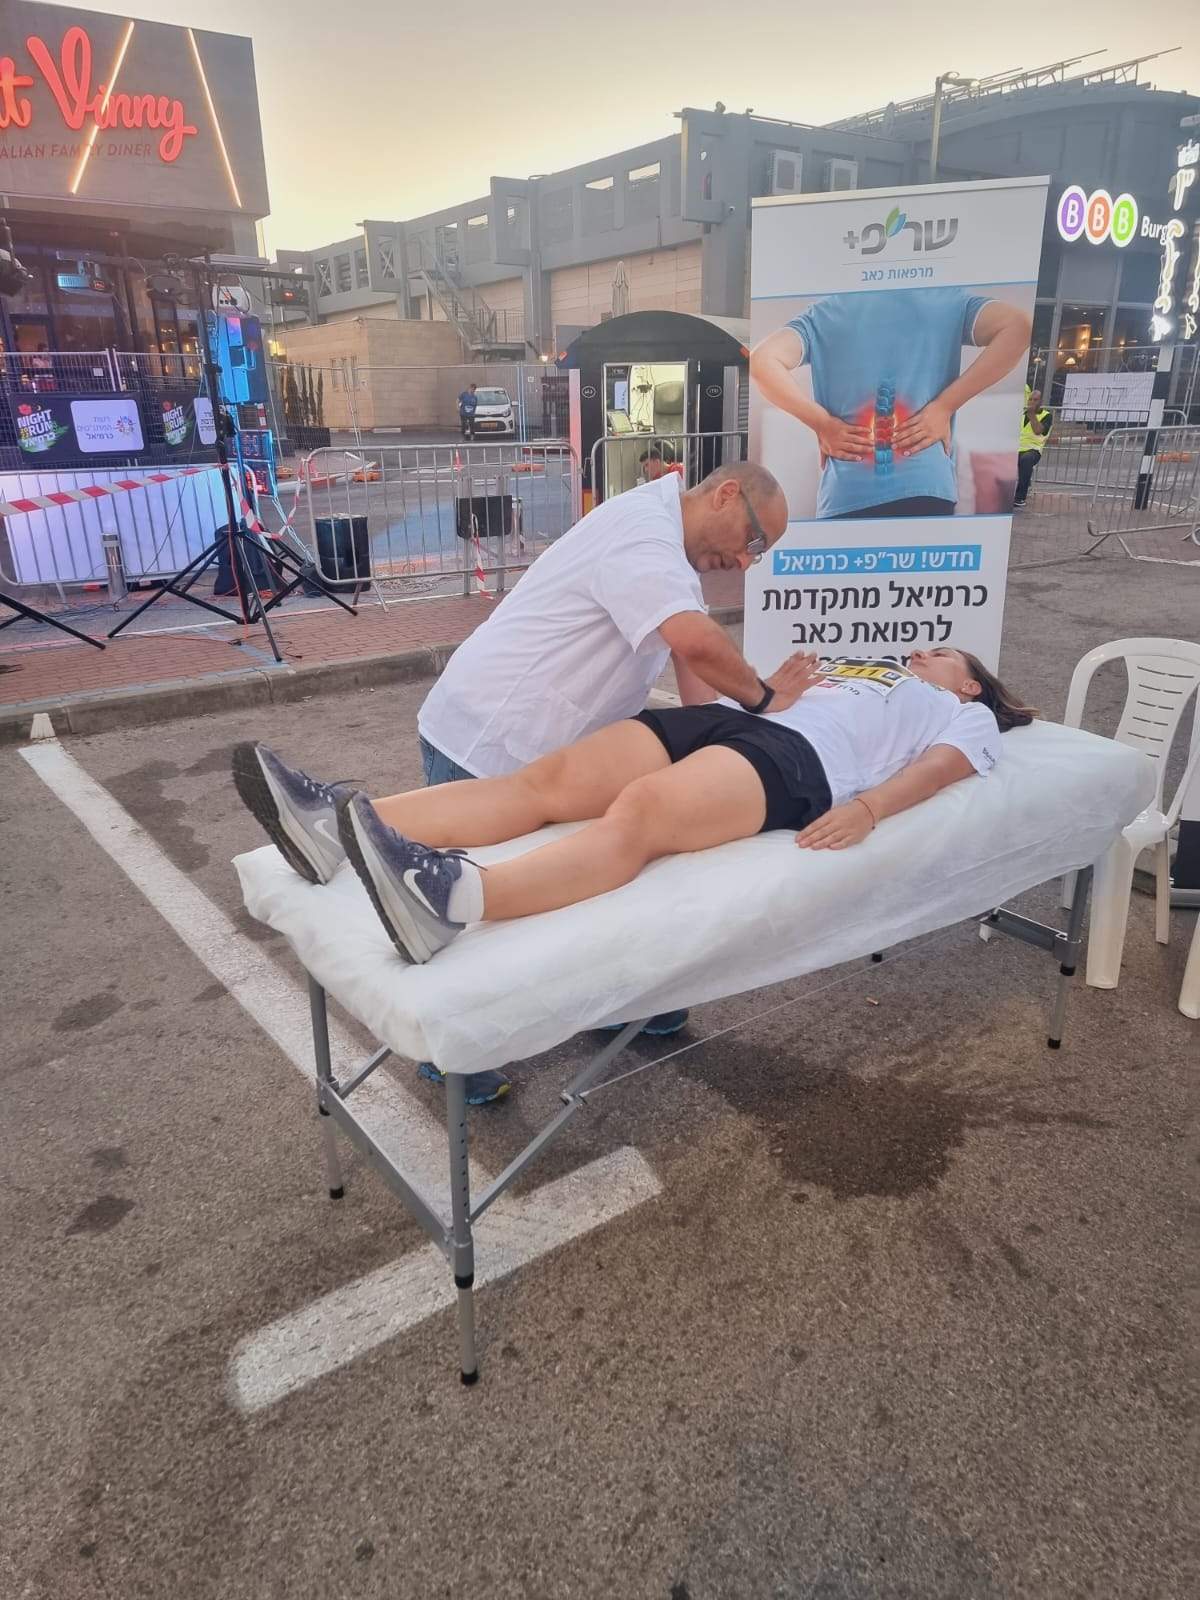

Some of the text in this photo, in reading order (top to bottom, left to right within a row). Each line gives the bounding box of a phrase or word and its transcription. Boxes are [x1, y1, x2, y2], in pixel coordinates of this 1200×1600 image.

[26, 26, 198, 162] Vinny
[0, 144, 46, 161] ALIAN
[107, 143, 152, 158] DINER
[1141, 216, 1170, 246] Burg
[861, 266, 934, 282] מרפאות כאב
[17, 409, 52, 428] NIGHT
[779, 551, 849, 572] כרמיאל
[921, 550, 974, 569] חדש!
[761, 580, 989, 616] כרמיאל מתקדמת
[791, 614, 953, 644] לרפואת כאב
[839, 666, 880, 677] 711
